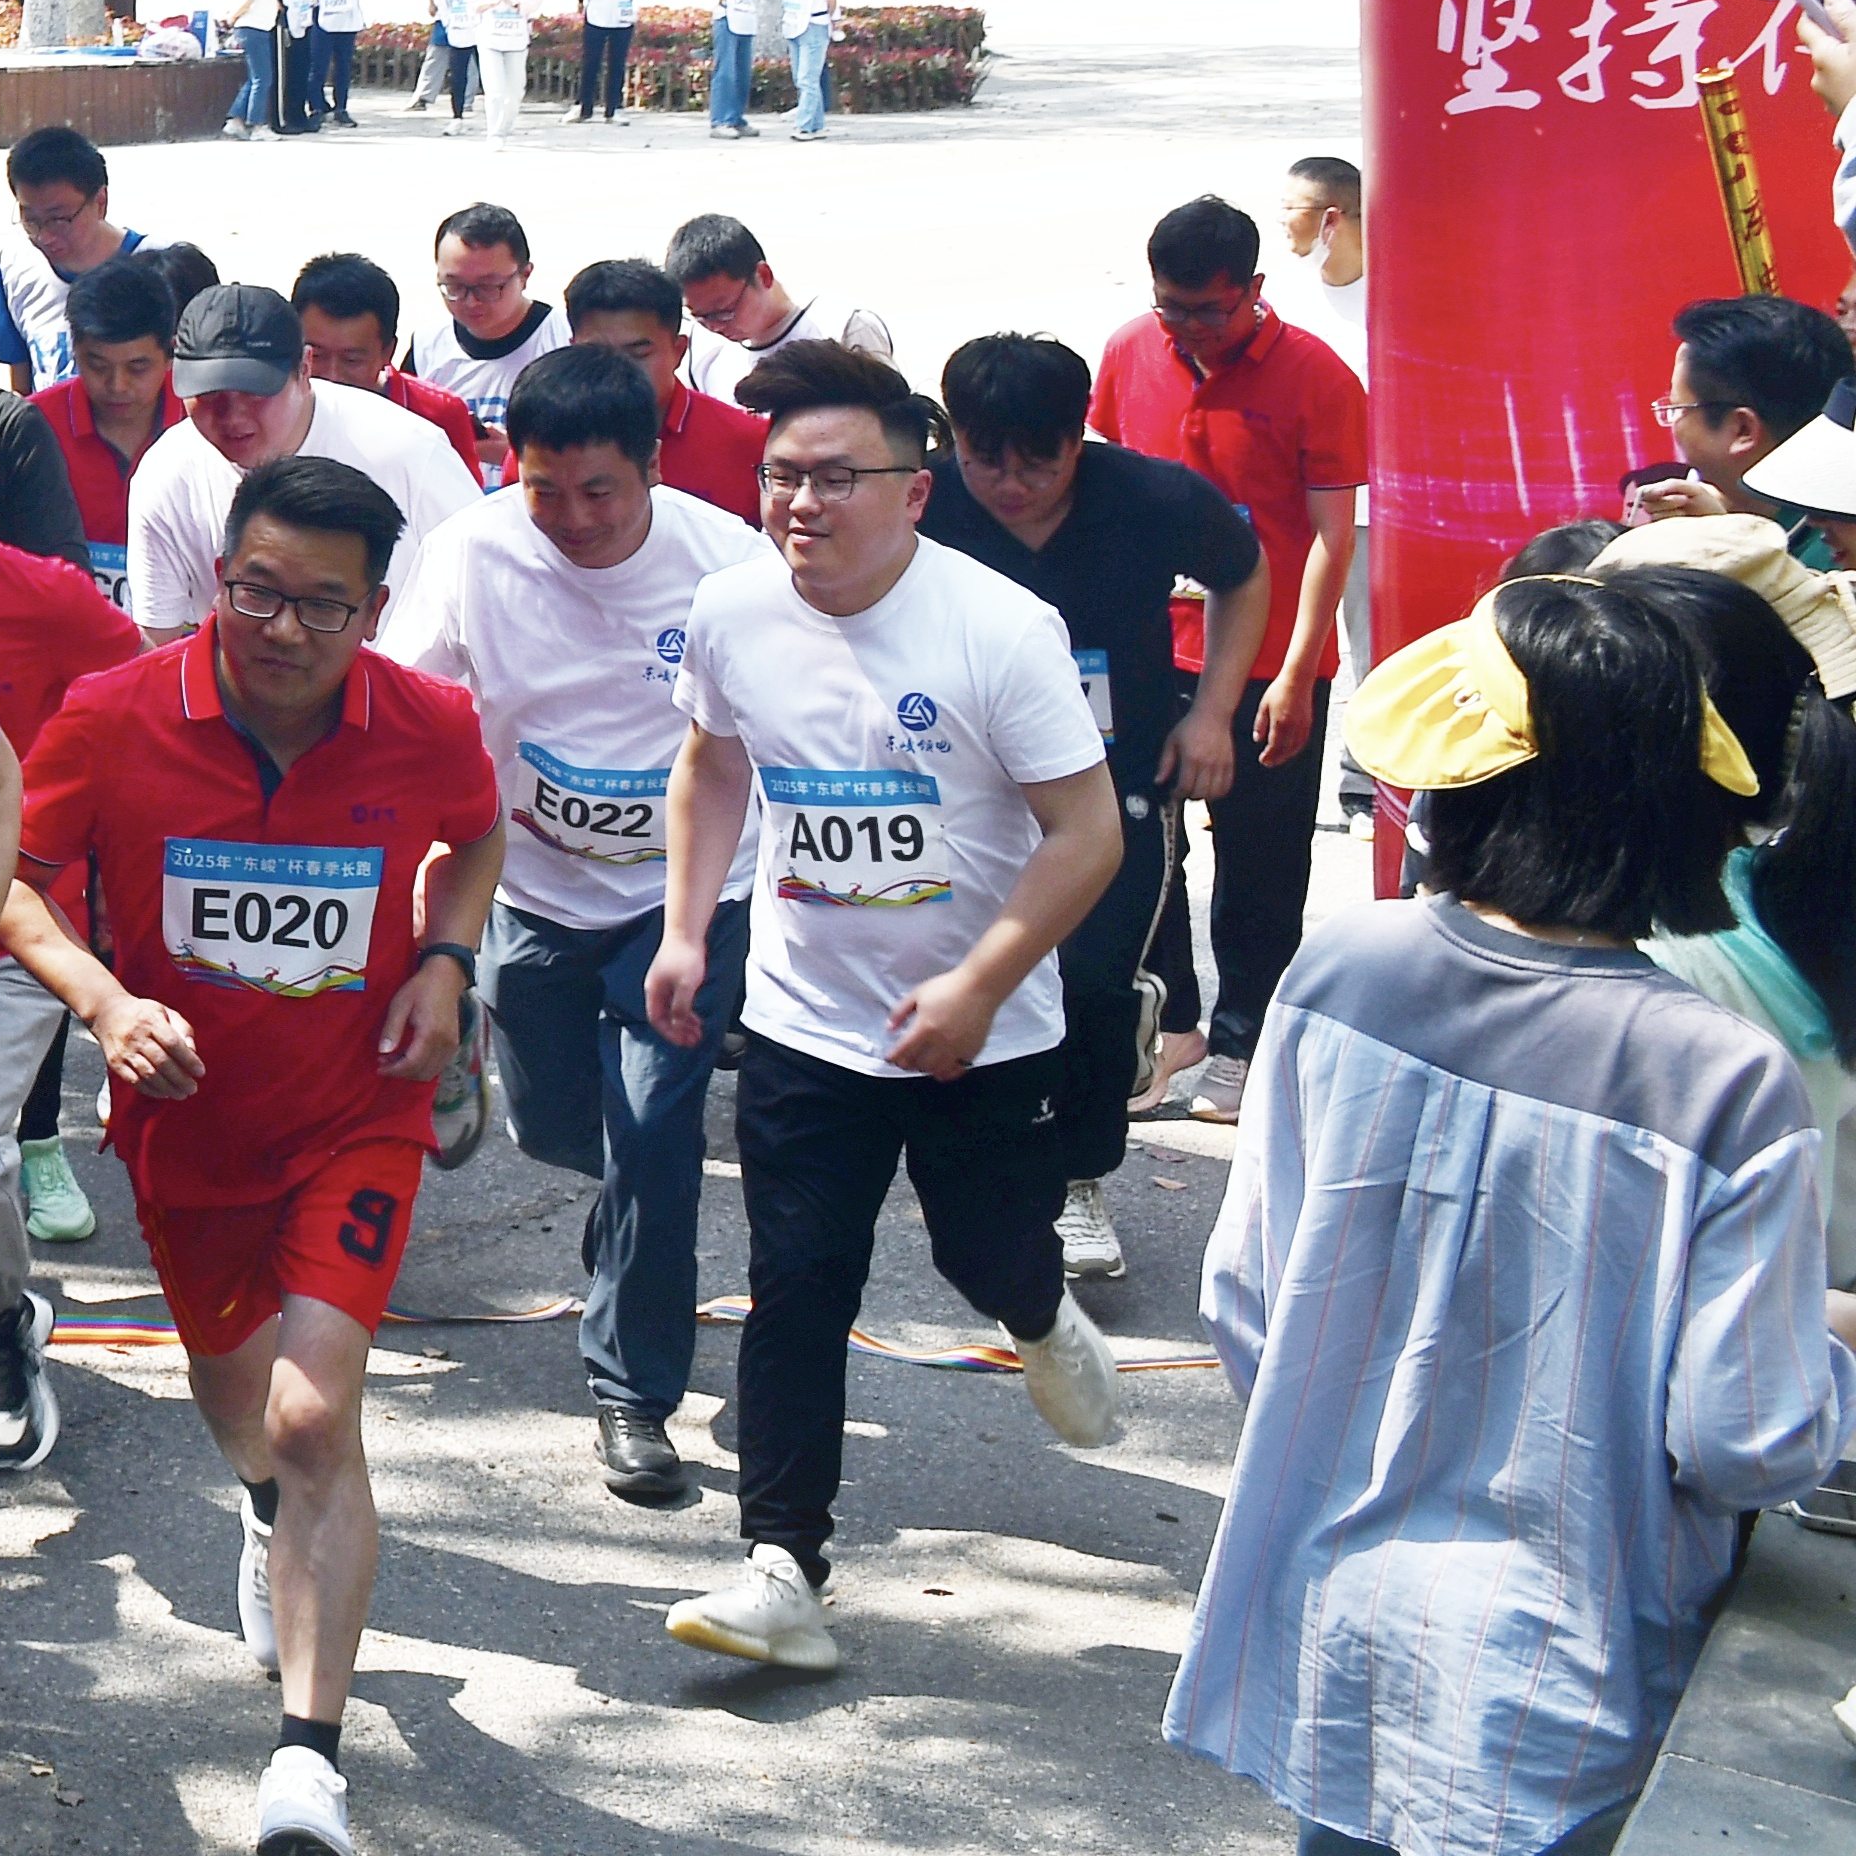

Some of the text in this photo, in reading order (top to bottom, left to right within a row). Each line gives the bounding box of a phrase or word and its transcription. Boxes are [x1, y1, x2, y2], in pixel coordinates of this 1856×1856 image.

[534, 776, 654, 838] E022
[789, 812, 925, 863] A019
[191, 887, 349, 950] E020
